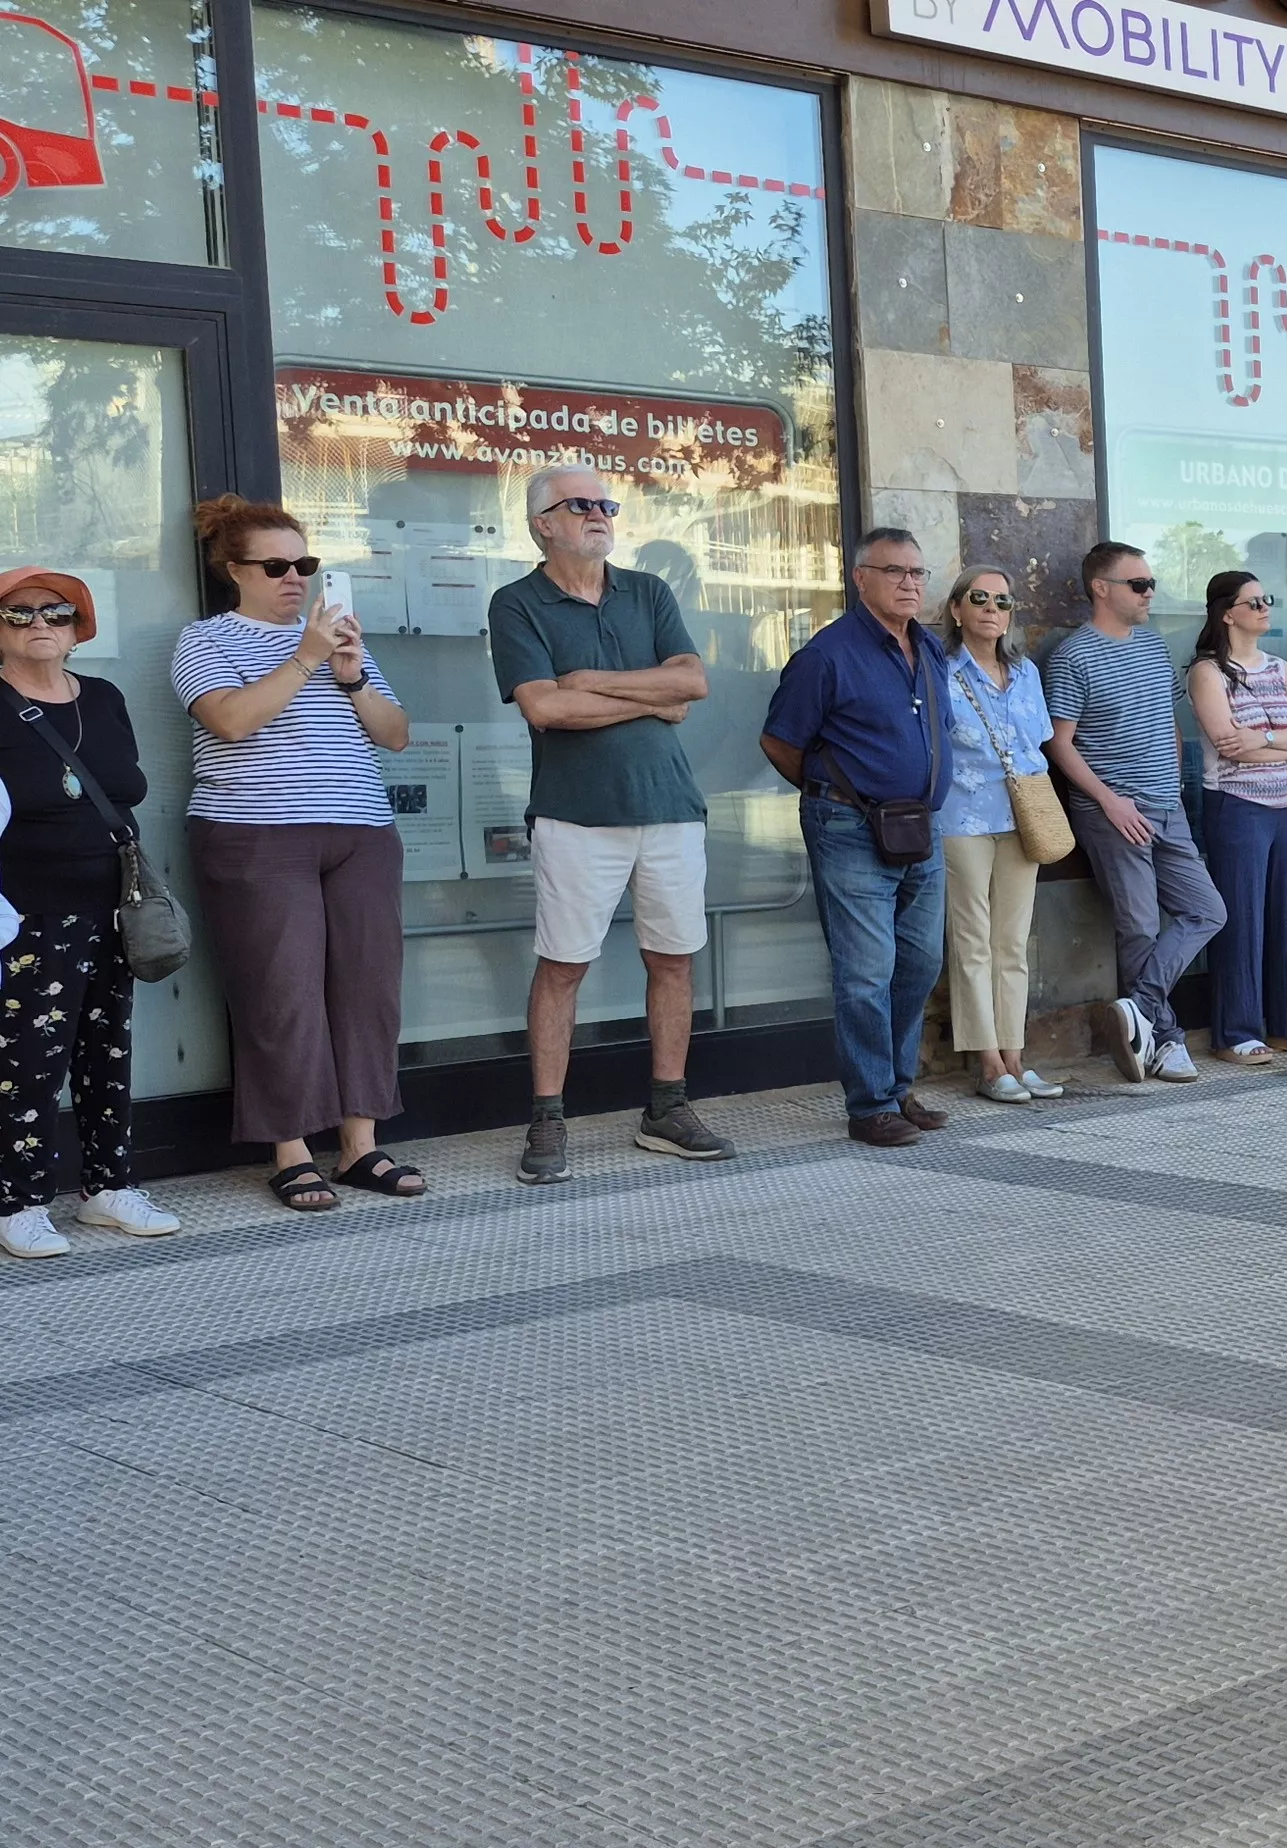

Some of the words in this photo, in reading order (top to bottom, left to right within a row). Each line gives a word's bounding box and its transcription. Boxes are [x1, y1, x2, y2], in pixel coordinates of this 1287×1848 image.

[983, 0, 1285, 93] MOBILITY
[293, 384, 397, 419] Venta
[411, 395, 591, 433] anticipada
[600, 410, 636, 438] de
[648, 412, 760, 447] billetes
[390, 437, 689, 475] www.avanzabus.com
[1180, 460, 1273, 489] URBANO
